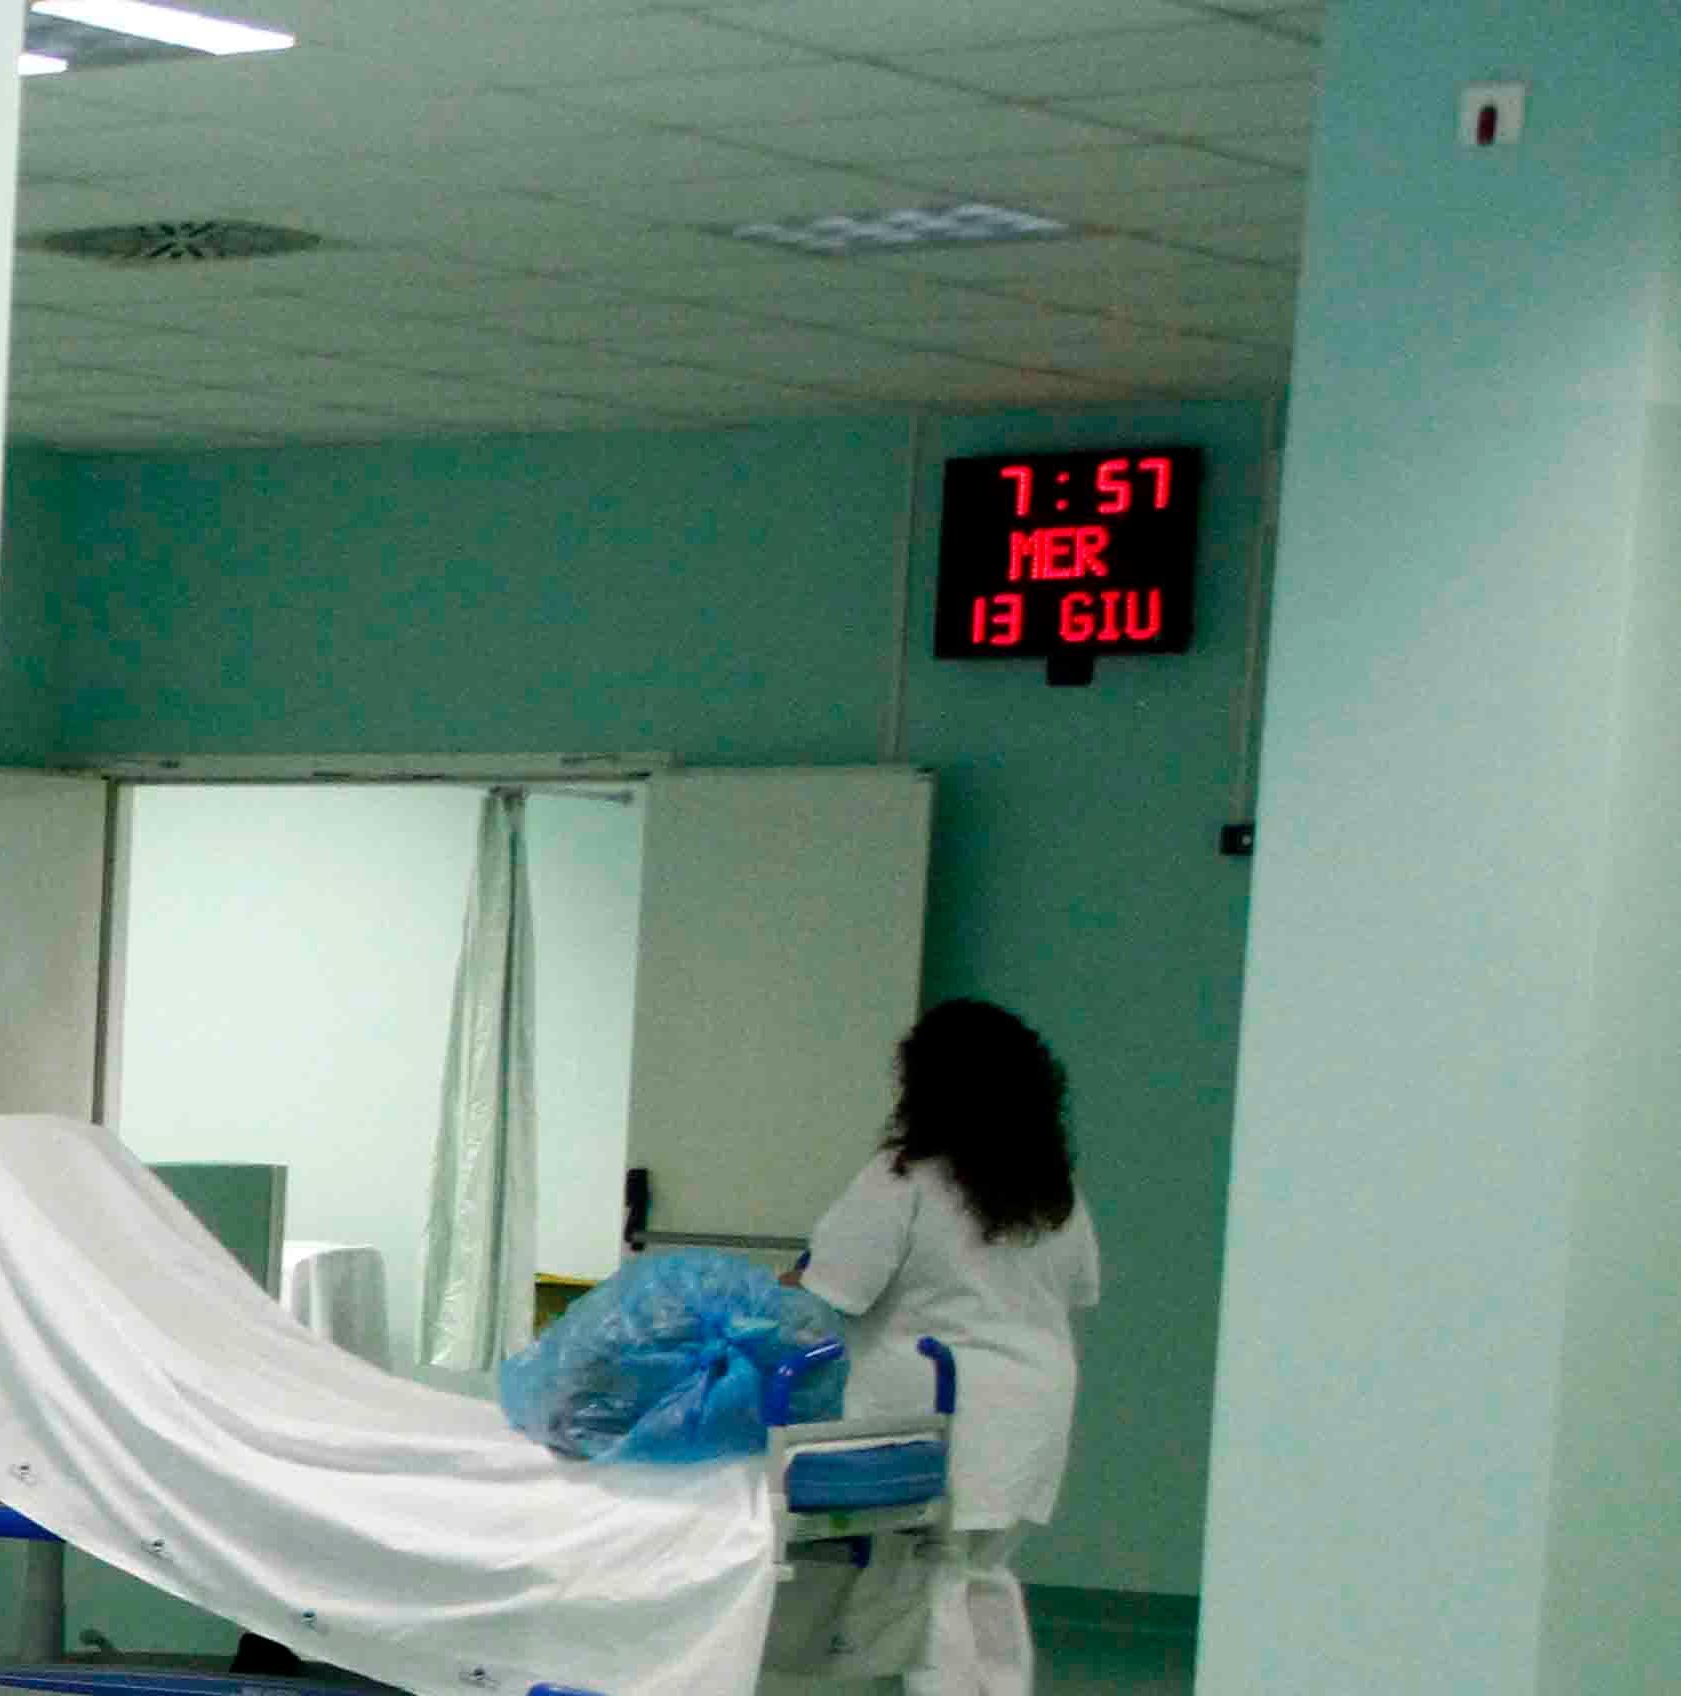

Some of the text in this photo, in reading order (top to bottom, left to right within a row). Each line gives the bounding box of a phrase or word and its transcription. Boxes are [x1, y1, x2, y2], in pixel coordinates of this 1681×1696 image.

[1000, 458, 1172, 516] 7:57
[1008, 526, 1110, 581] MER
[972, 588, 1162, 645] 13 GIU
